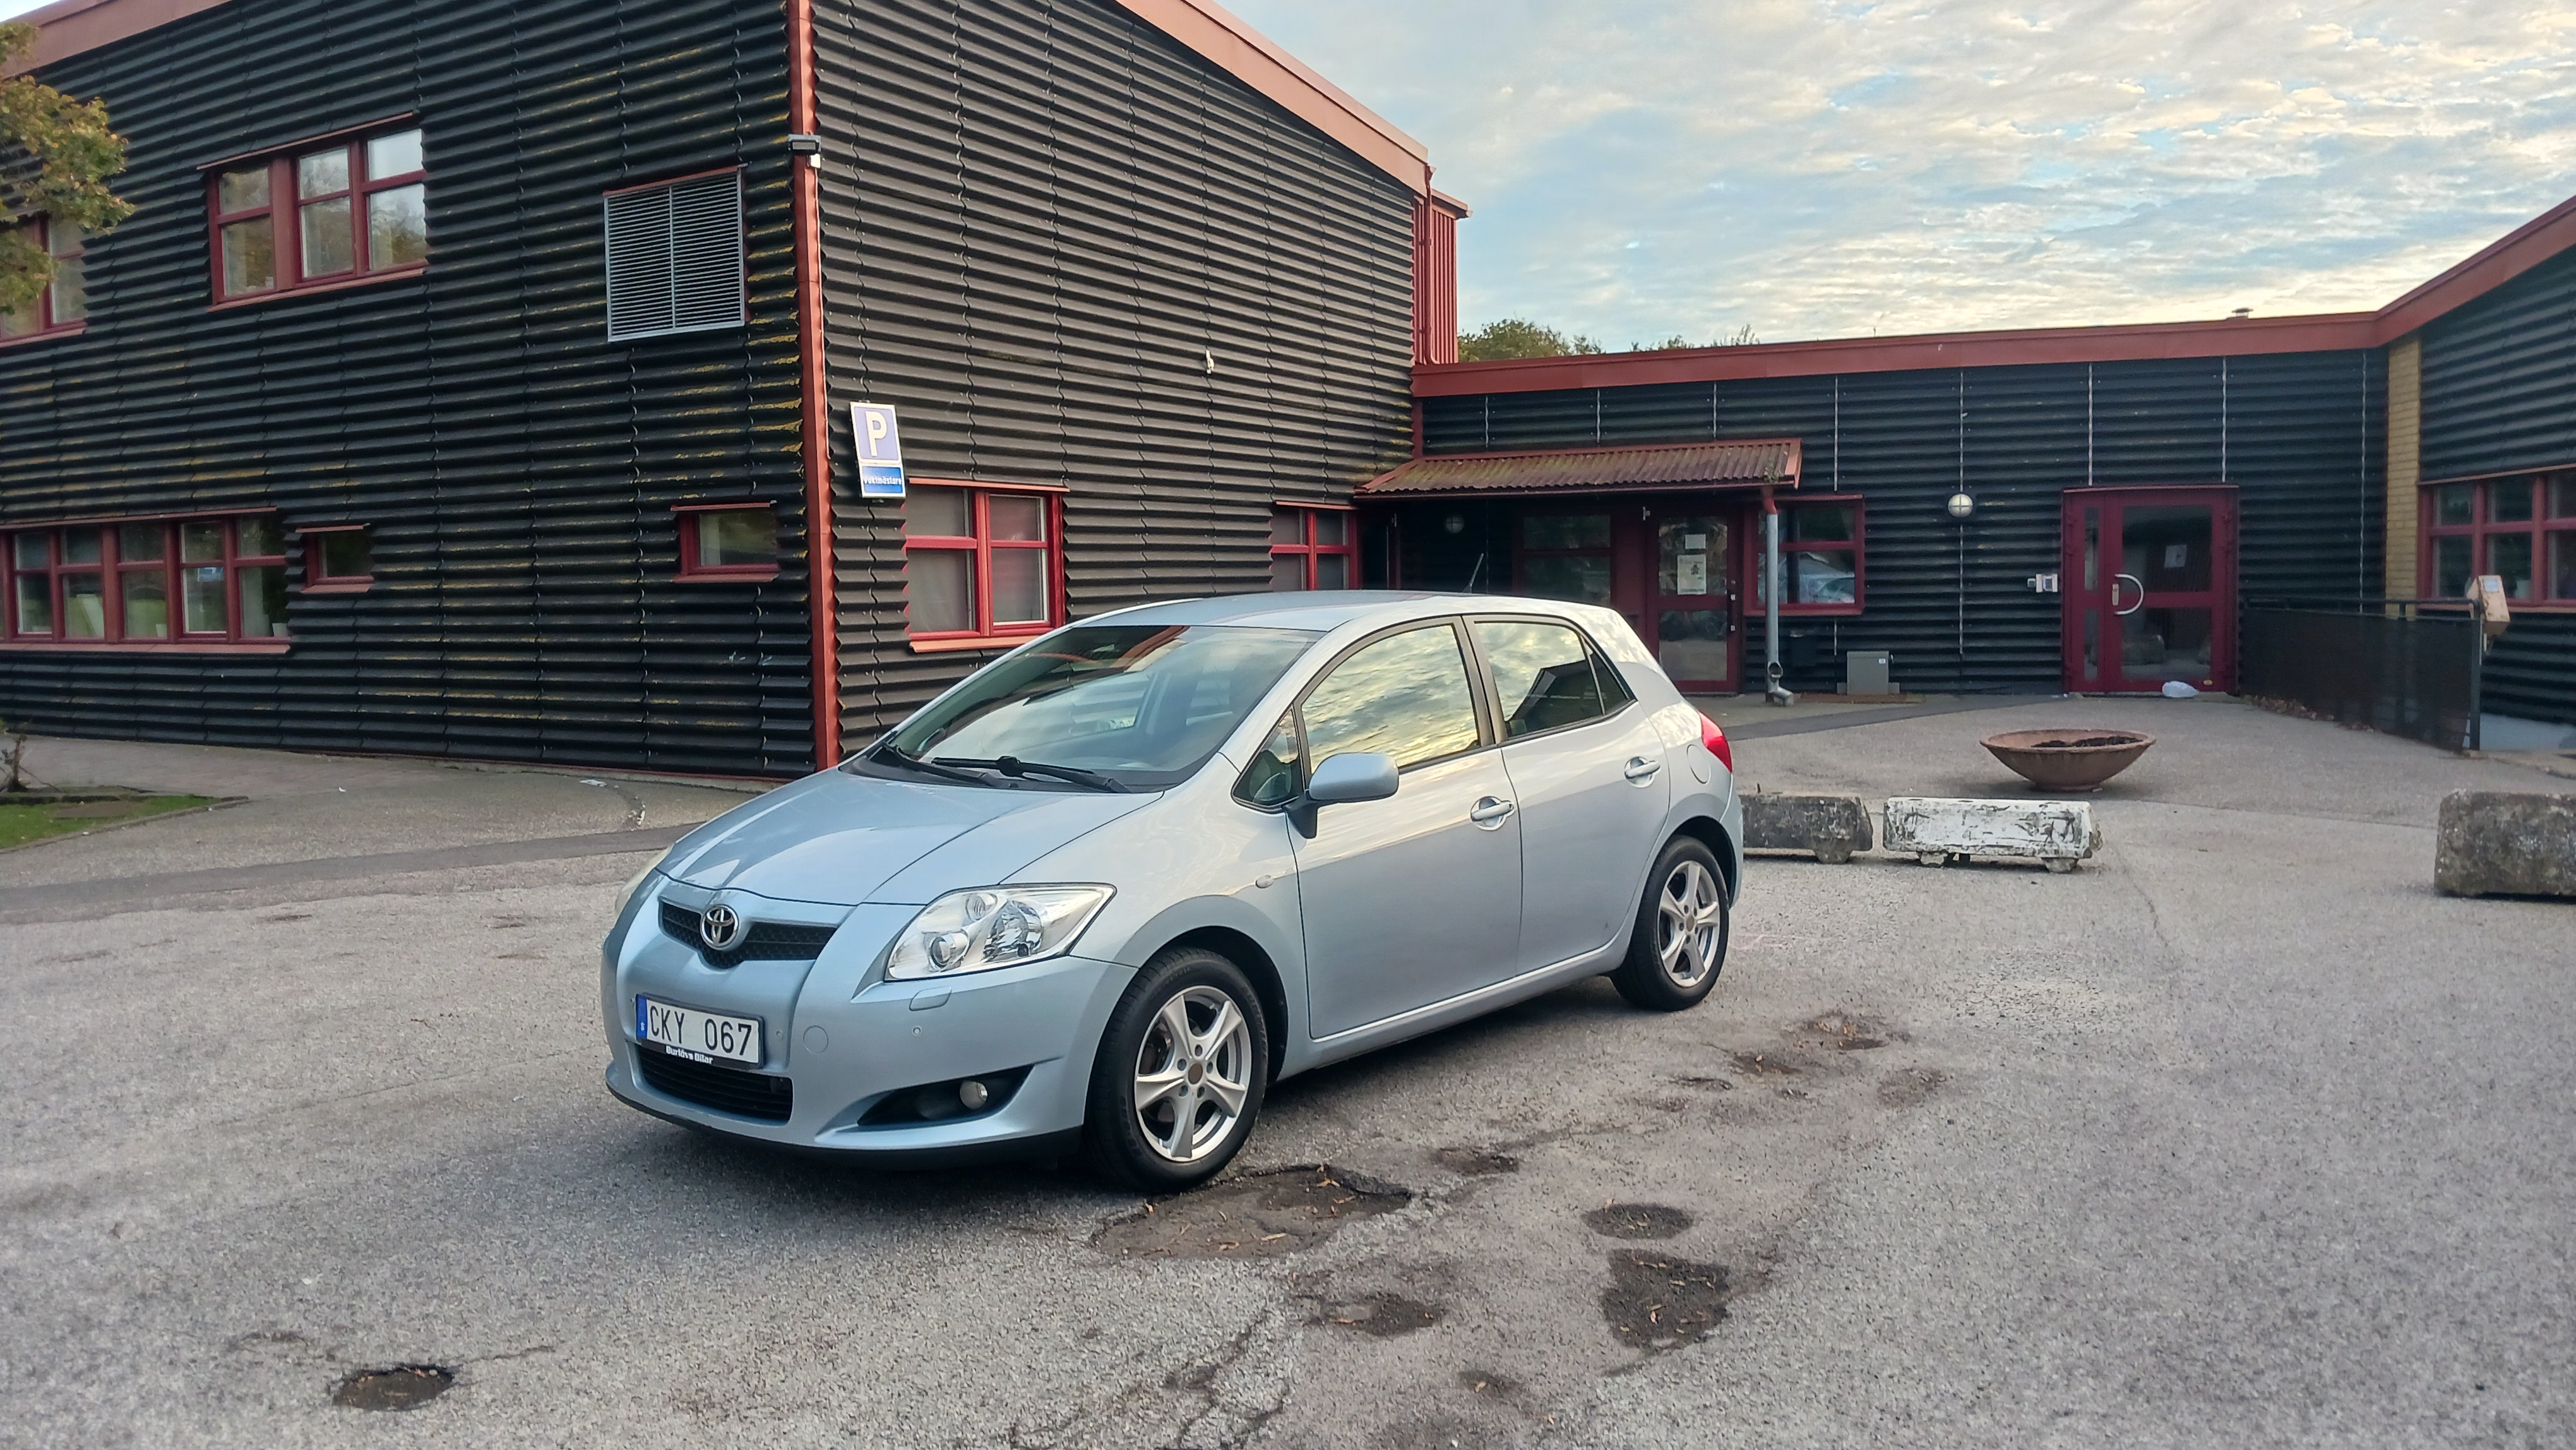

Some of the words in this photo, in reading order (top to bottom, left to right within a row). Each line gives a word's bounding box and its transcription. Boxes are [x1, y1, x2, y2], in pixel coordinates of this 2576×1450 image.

[865, 411, 887, 457] P
[650, 1005, 684, 1044] CKY
[705, 1019, 752, 1055] 067
[695, 1052, 713, 1065] Bilar
